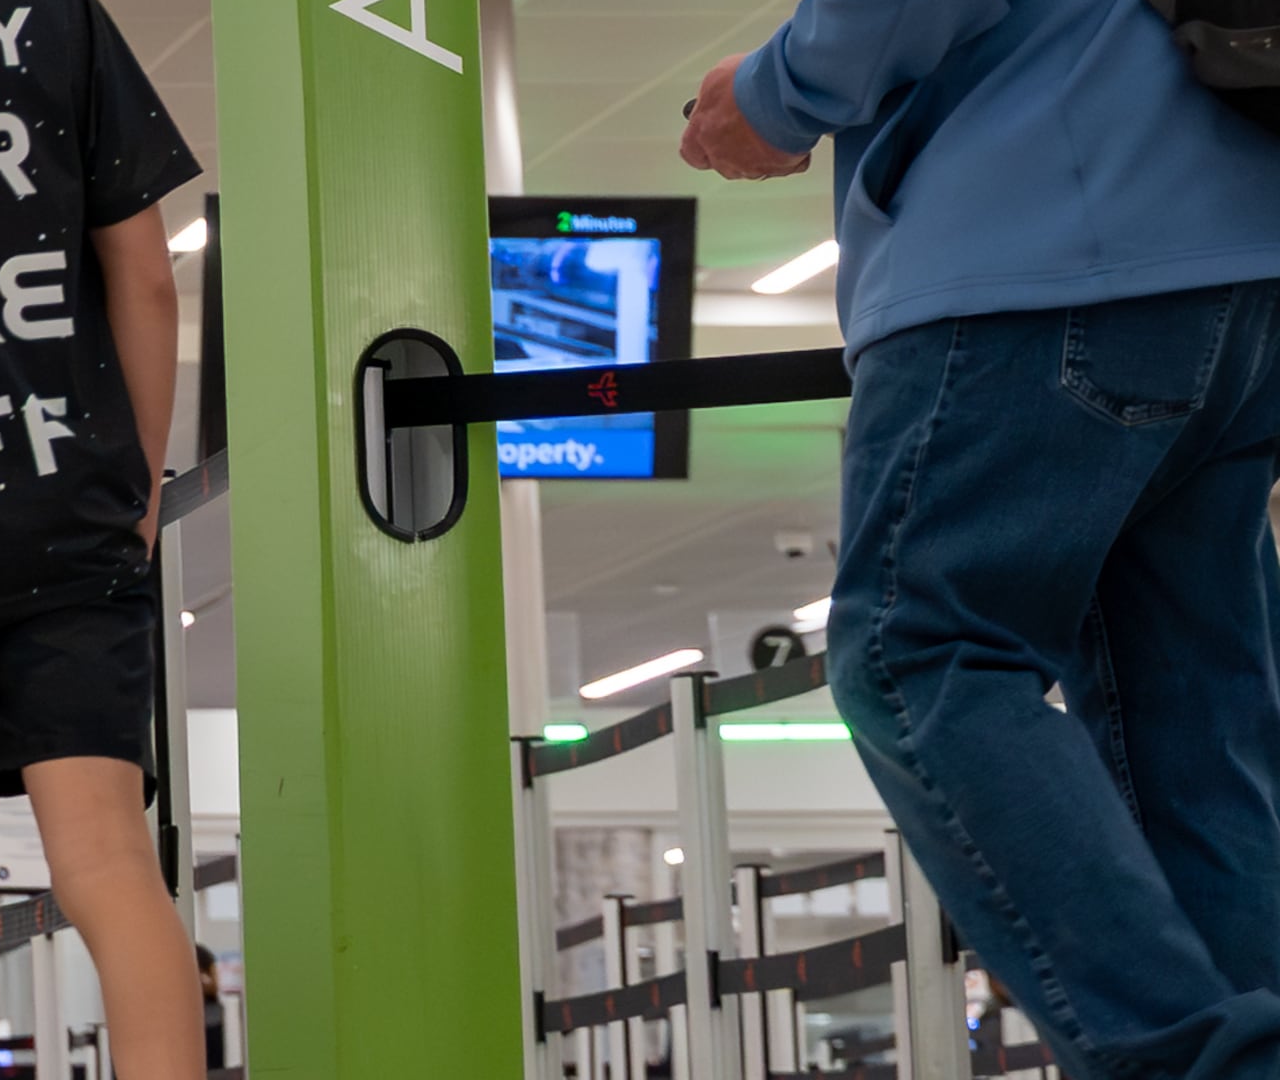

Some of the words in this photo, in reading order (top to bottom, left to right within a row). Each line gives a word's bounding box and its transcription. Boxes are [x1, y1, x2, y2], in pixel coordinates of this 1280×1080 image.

[556, 211, 572, 232] 2
[572, 214, 637, 233] Minutes
[498, 438, 604, 471] operty.
[763, 637, 792, 668] 7
